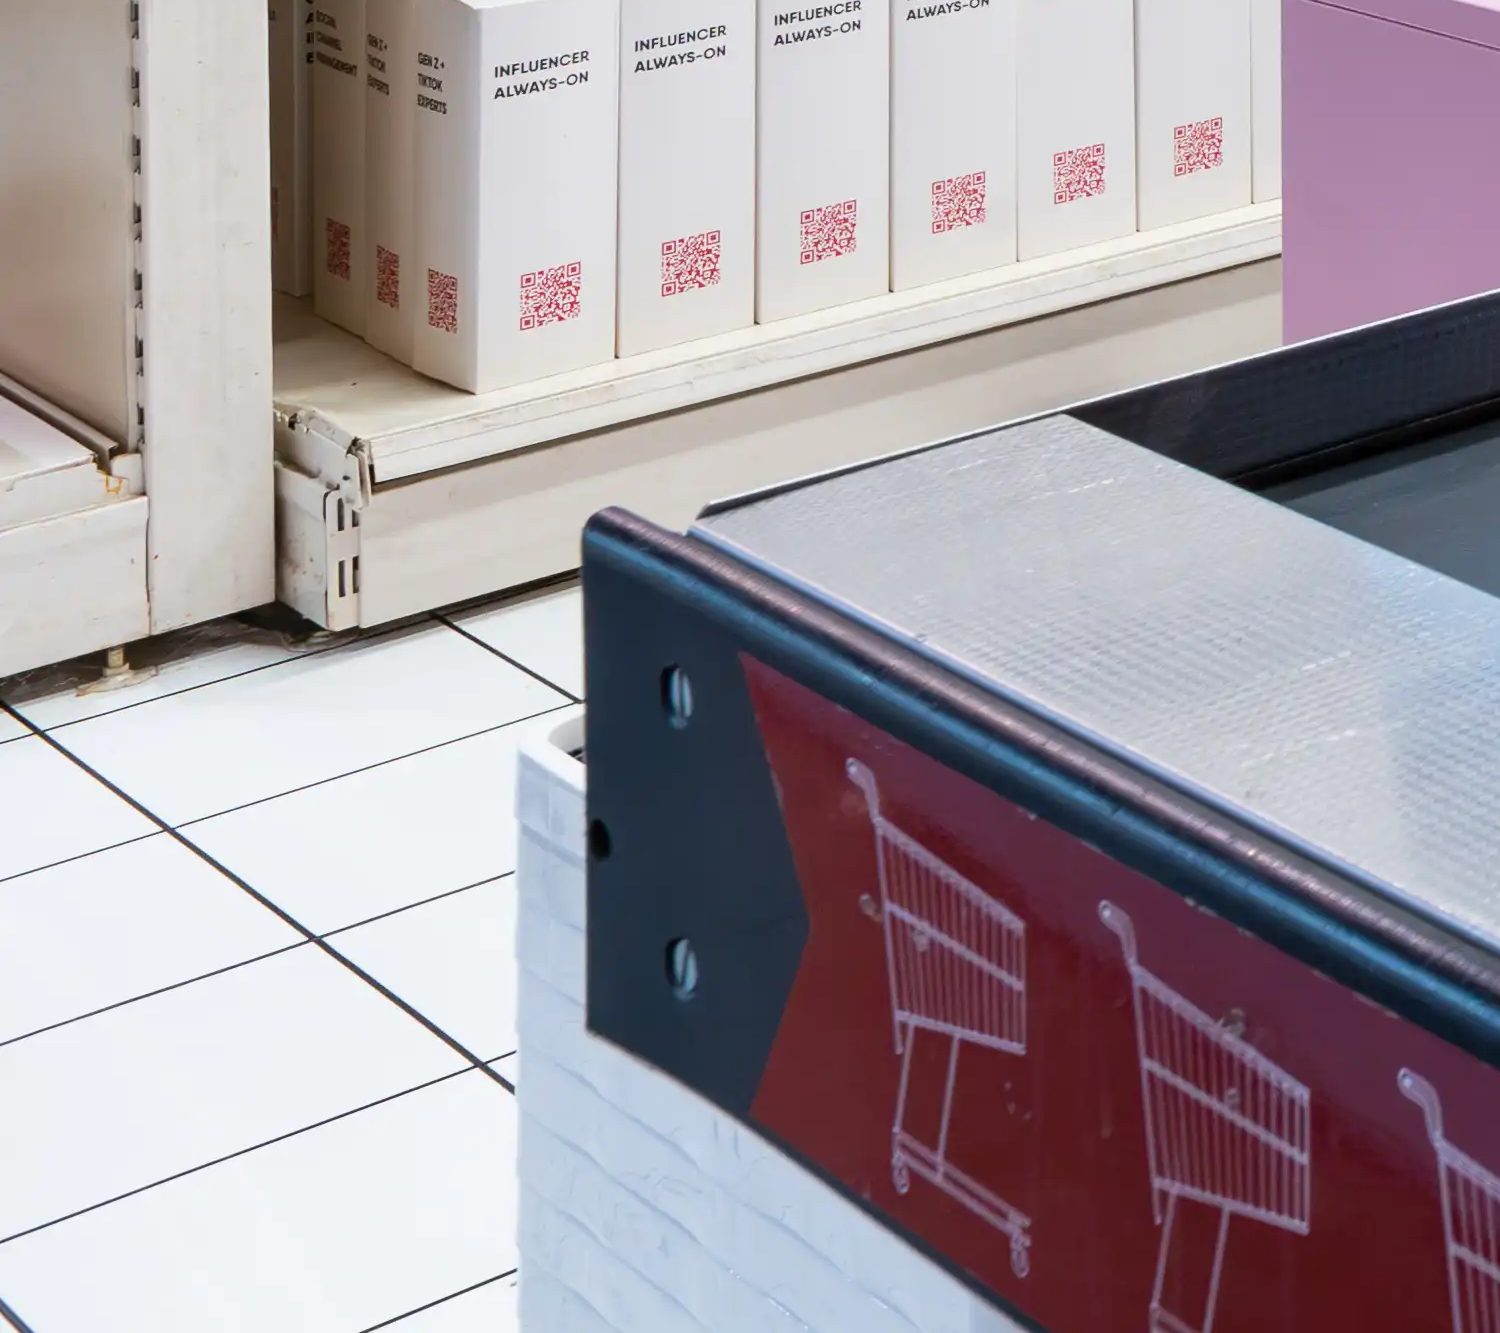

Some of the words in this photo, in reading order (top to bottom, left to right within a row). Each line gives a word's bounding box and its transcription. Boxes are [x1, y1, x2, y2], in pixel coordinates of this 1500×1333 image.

[774, 0, 862, 27] INFLUENCER
[773, 19, 861, 46] ALWAYS-ON
[494, 50, 590, 79] INFLUENCER
[494, 70, 589, 100] ALWAYS-ON
